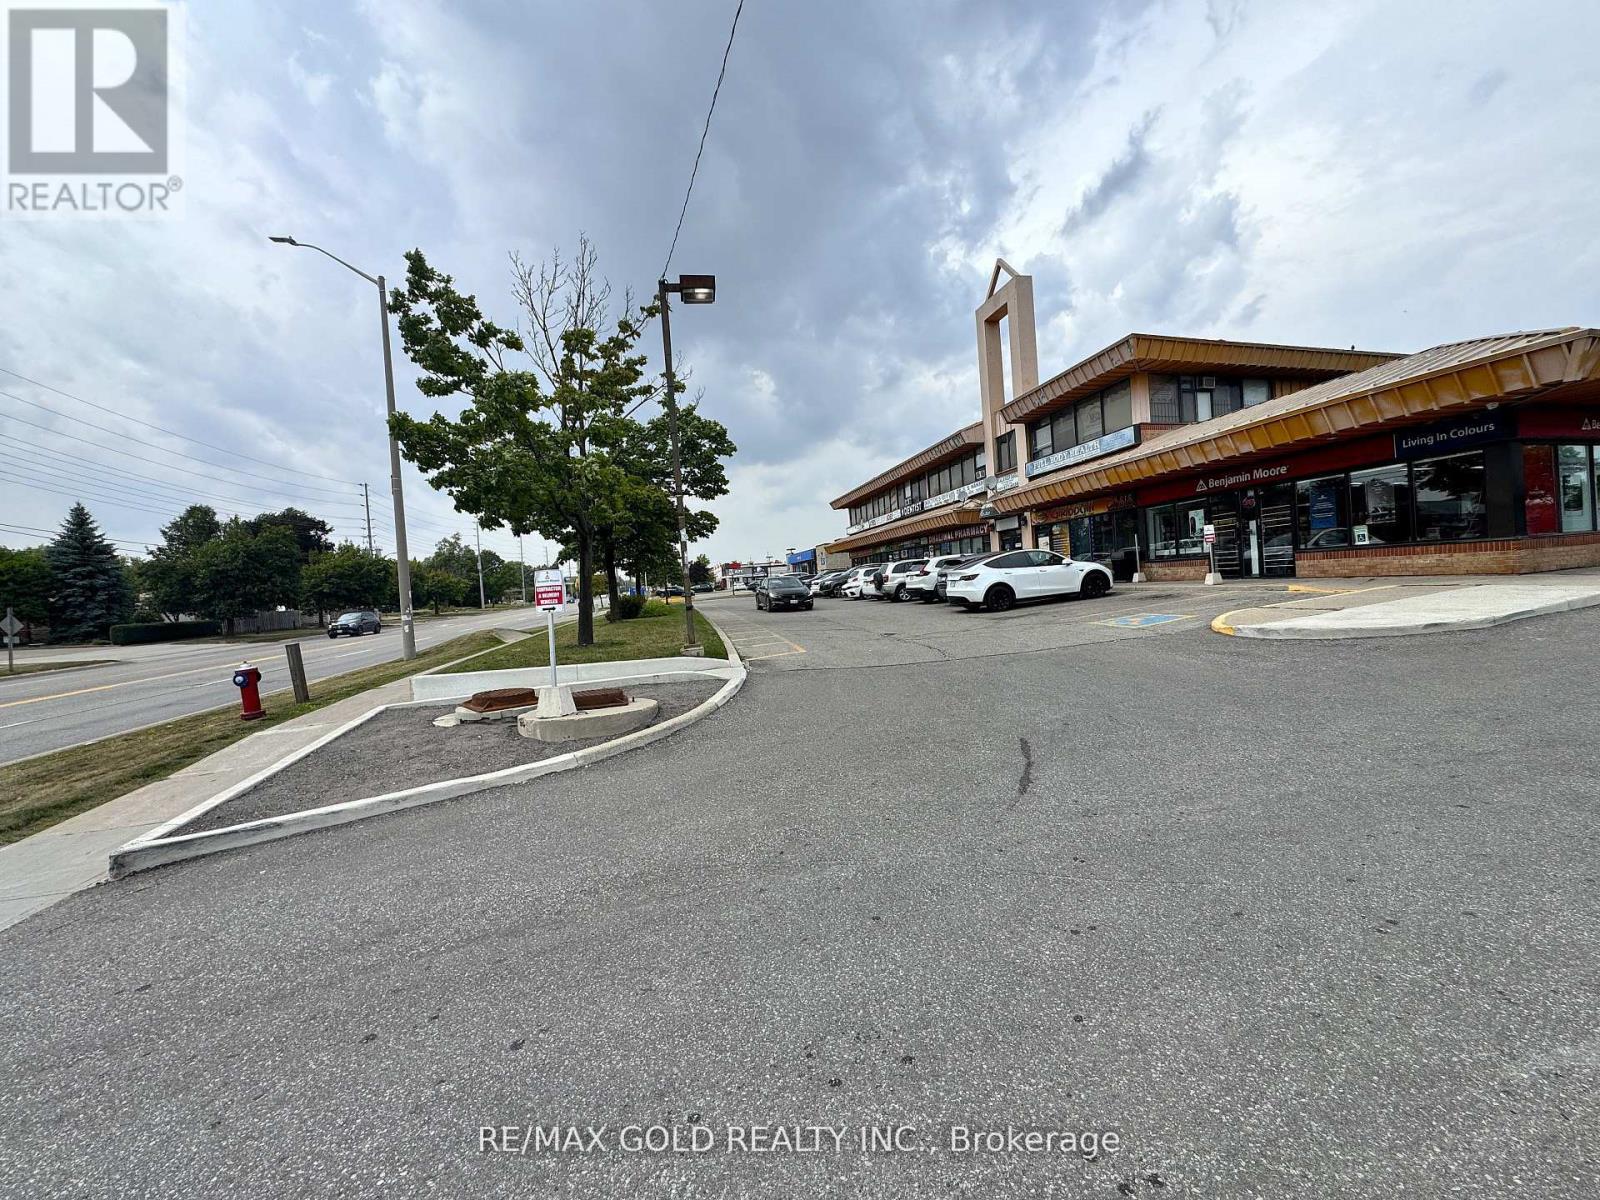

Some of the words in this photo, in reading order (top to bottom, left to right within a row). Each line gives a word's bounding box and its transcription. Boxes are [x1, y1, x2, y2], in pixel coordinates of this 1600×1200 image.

[1402, 436, 1434, 449] Living
[1436, 433, 1447, 441] In
[1449, 423, 1495, 438] Colours
[1208, 471, 1251, 488] Benjamin
[1252, 465, 1288, 480] Moore
[904, 501, 922, 516] DENTIST
[954, 524, 988, 539] PHARMACY
